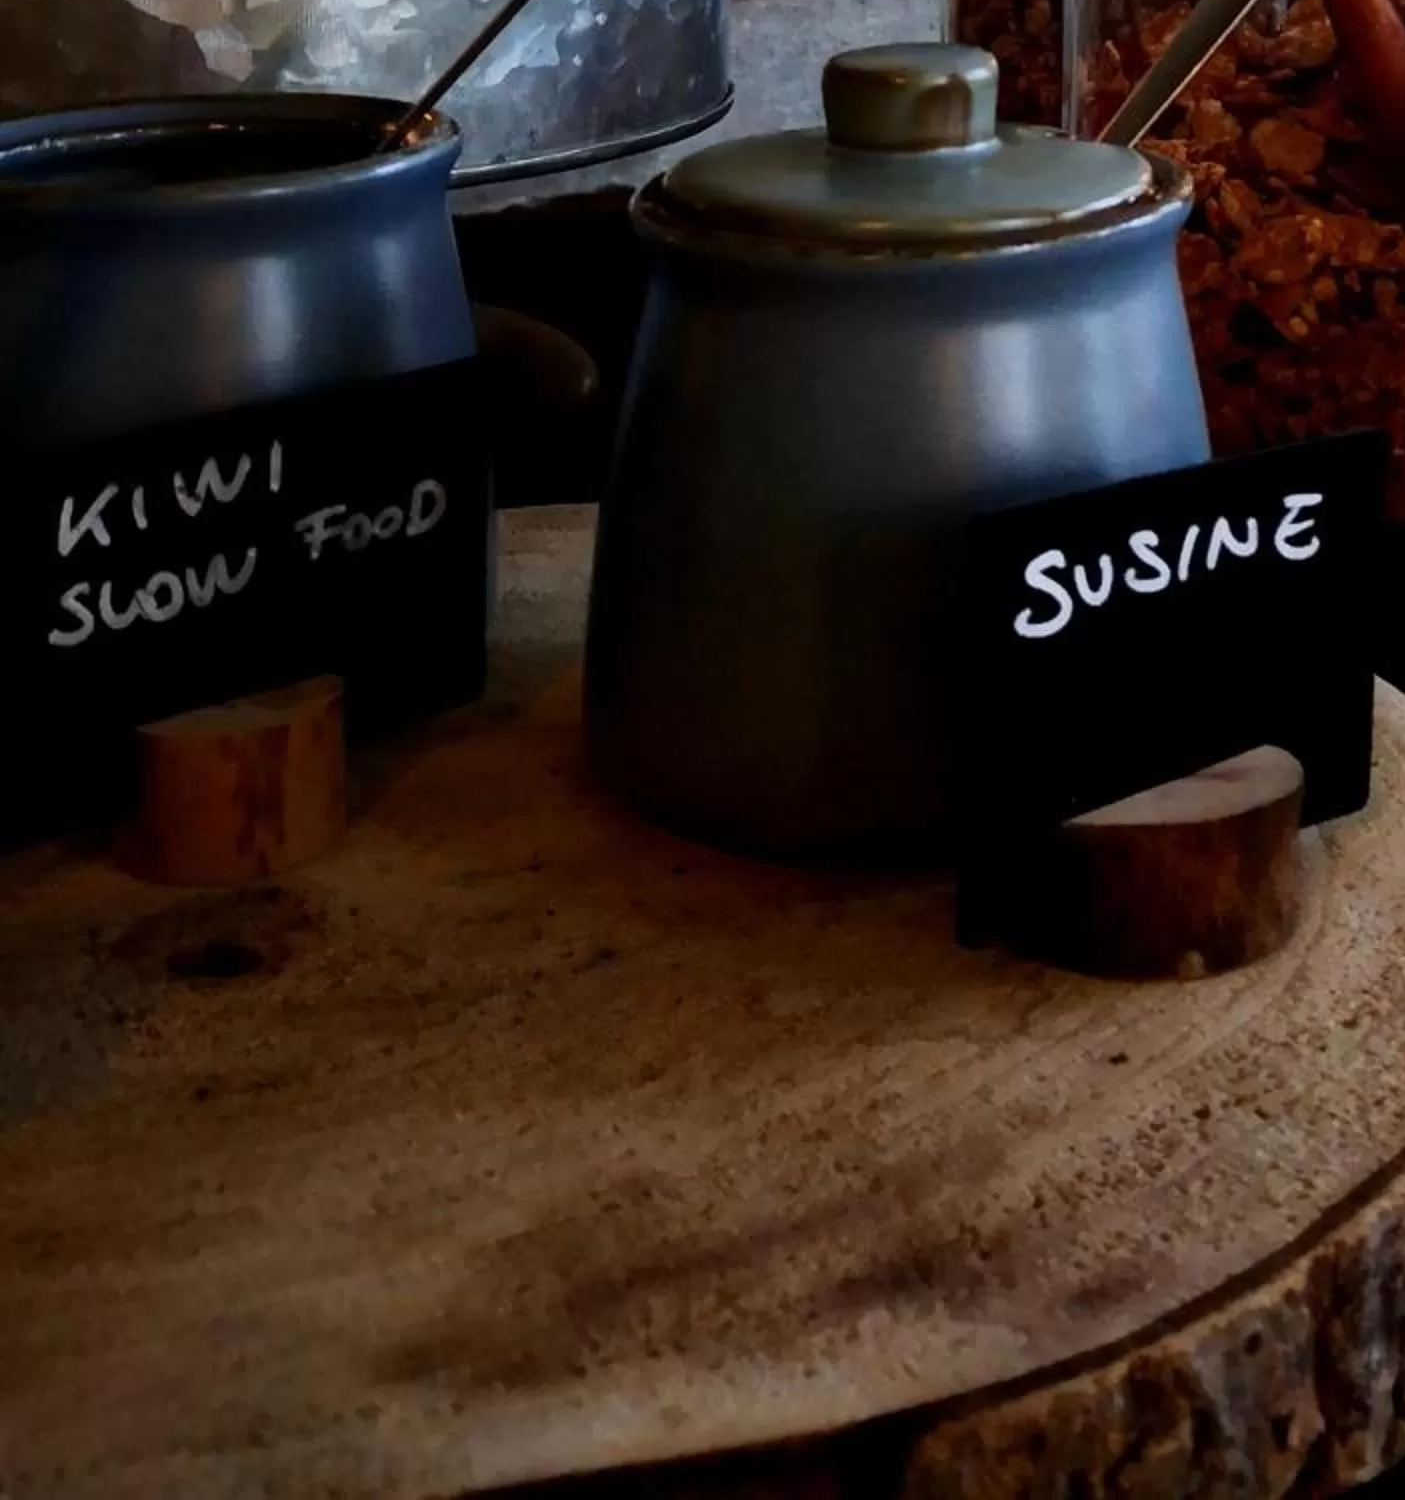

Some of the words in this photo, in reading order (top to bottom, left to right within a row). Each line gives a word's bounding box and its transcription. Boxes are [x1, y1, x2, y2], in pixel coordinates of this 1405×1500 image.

[48, 547, 257, 647] SLOW
[295, 478, 447, 561] FOOD
[57, 439, 283, 558] KIWI
[1013, 493, 1324, 639] SUSINE
